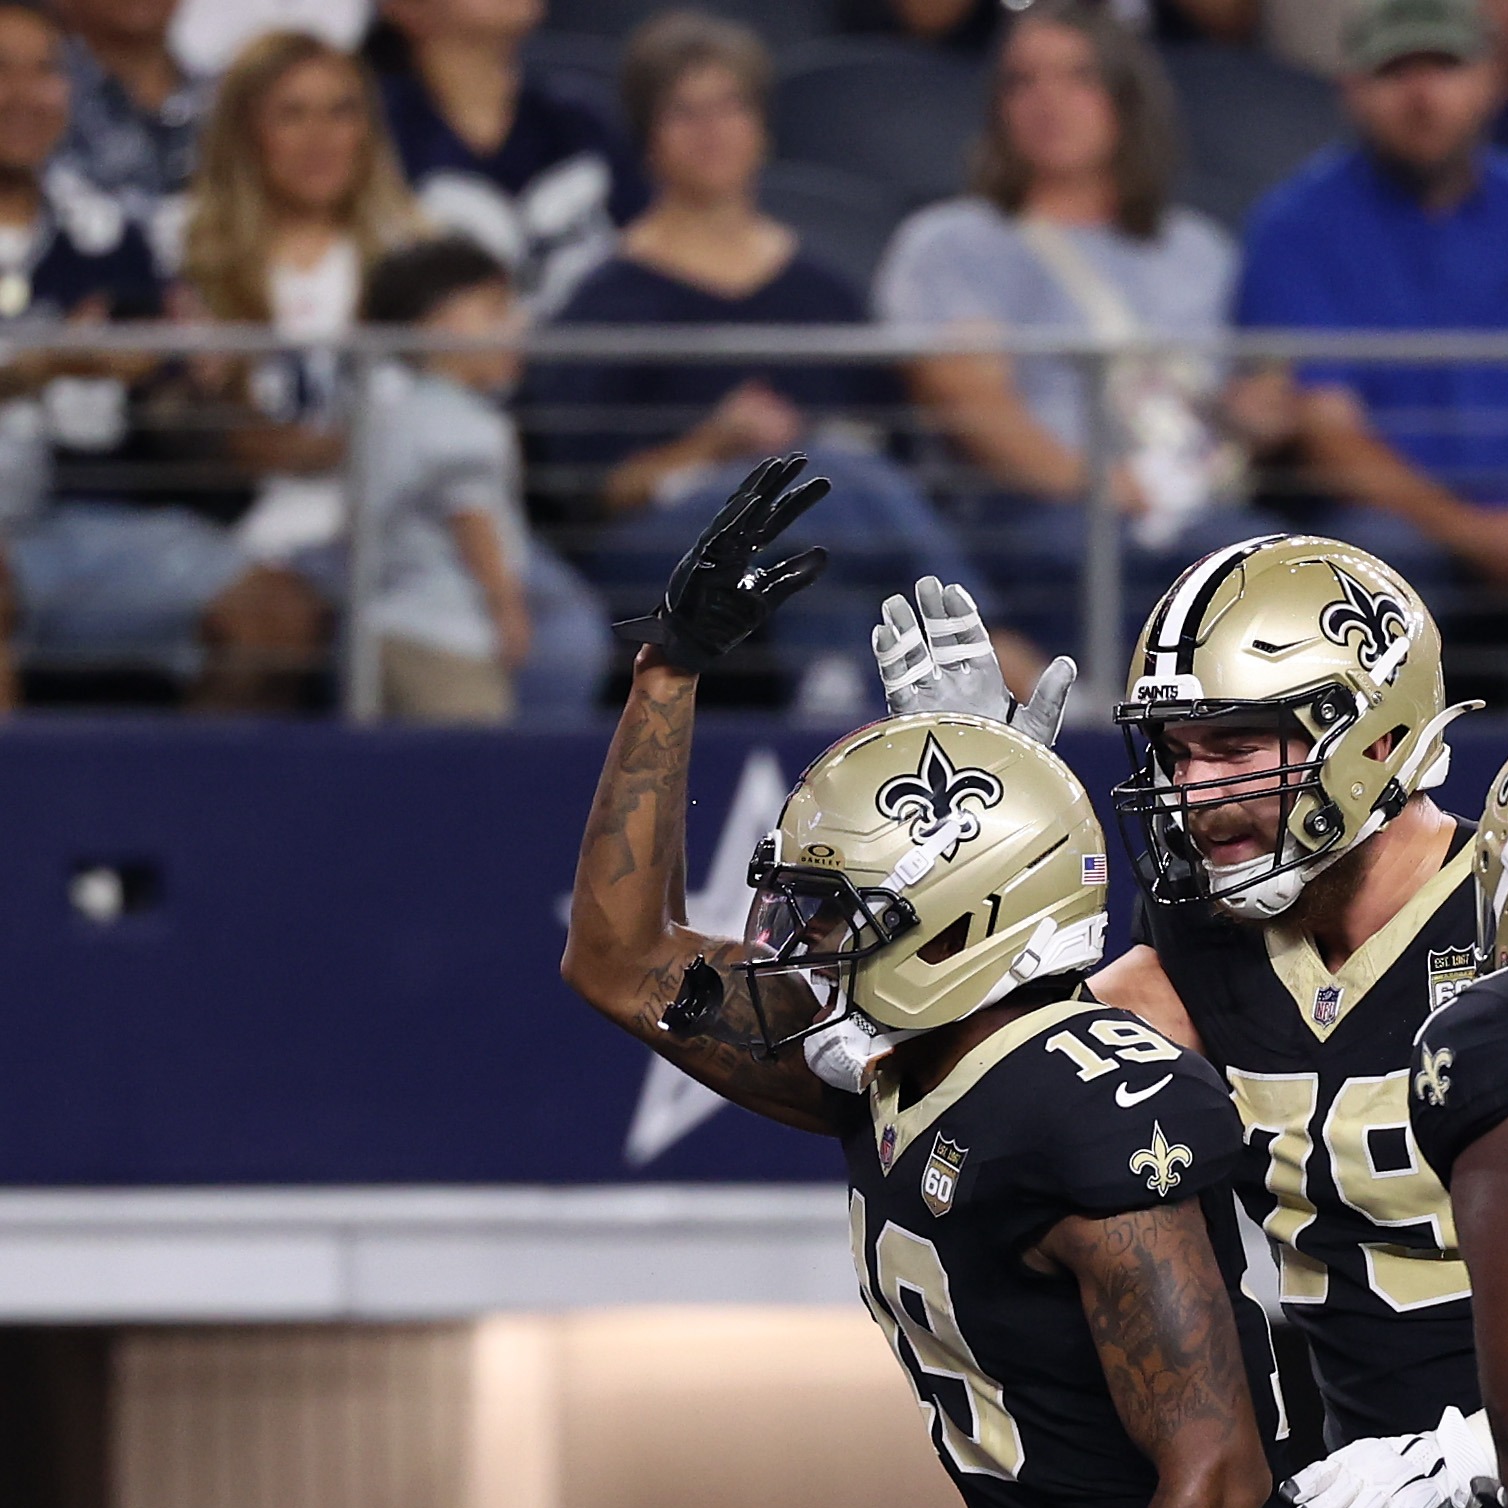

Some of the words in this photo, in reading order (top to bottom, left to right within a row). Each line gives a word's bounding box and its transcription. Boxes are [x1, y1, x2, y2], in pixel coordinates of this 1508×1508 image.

[1137, 684, 1179, 701] SAINTS
[801, 857, 841, 866] OAKLEY
[1044, 1019, 1183, 1082] 19
[925, 1166, 953, 1203] 60
[1226, 1065, 1473, 1312] 79
